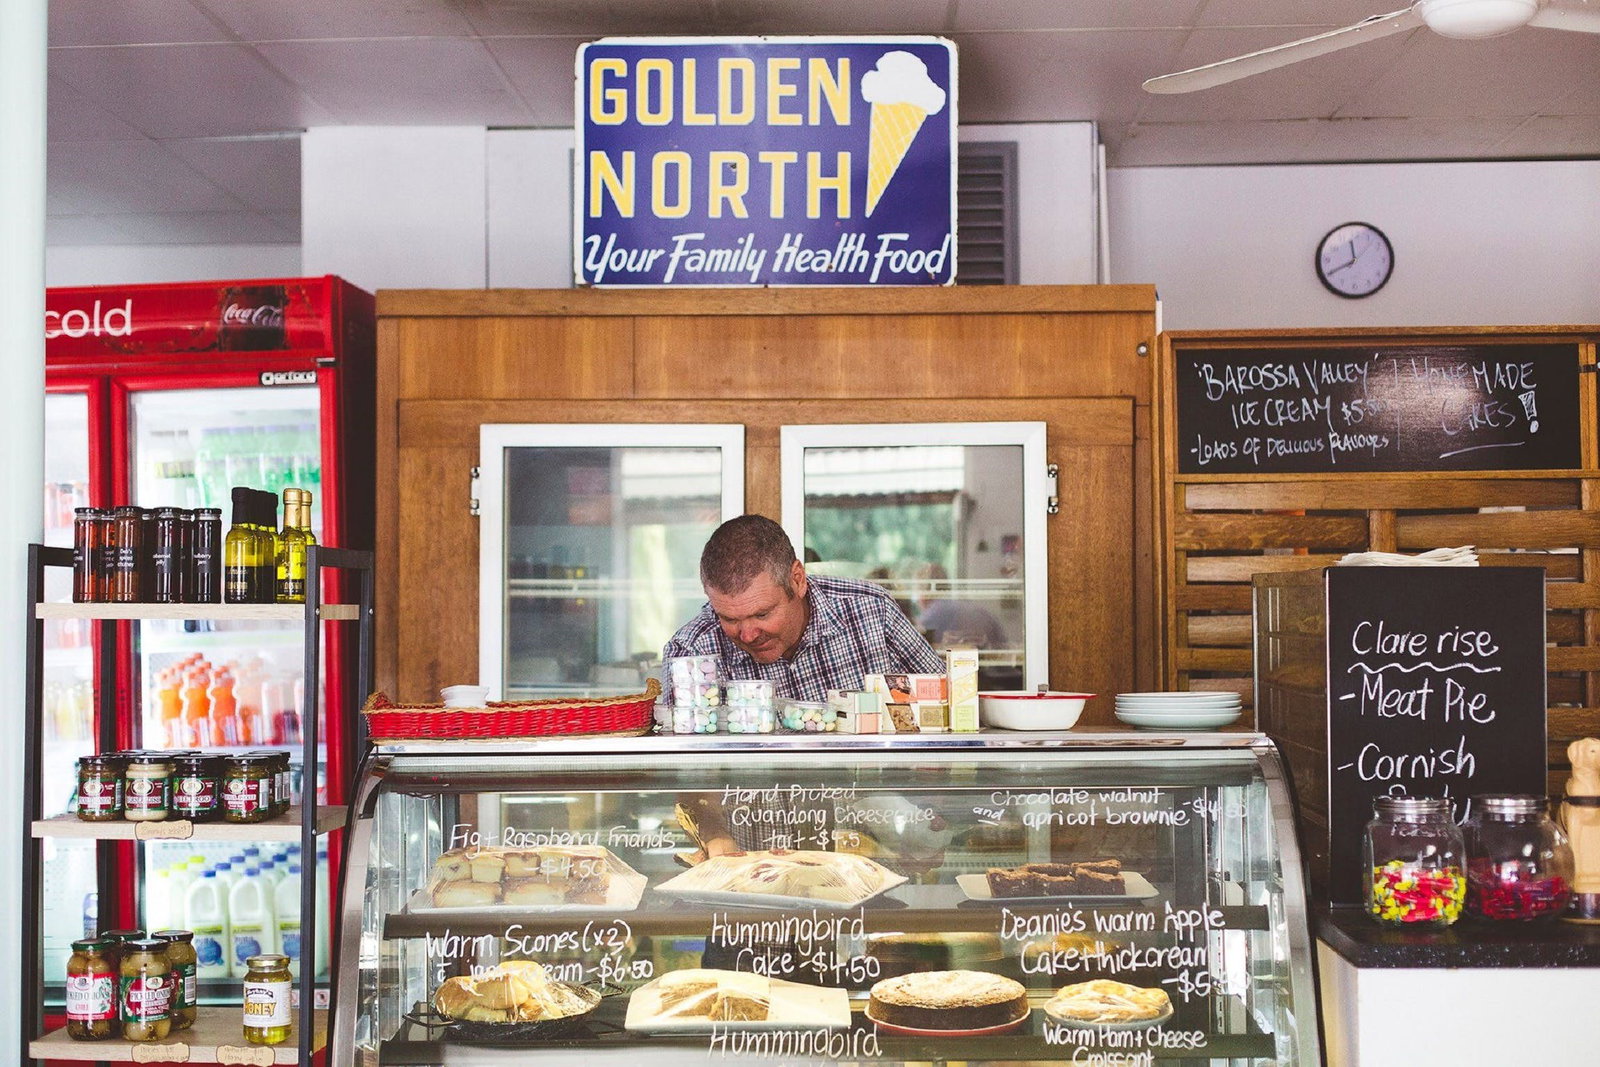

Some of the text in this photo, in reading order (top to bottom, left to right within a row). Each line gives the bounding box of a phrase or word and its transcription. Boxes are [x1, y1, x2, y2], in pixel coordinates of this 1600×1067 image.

[589, 57, 851, 126] GOLDEN
[589, 150, 852, 219] NORTH
[584, 232, 952, 284] Your Family Health Food
[1231, 401, 1261, 429] ICE
[1264, 394, 1335, 433] CREAM
[1242, 437, 1261, 465] OF
[1351, 620, 1500, 657] Clare rise
[1445, 677, 1496, 724] Pie
[721, 781, 857, 806] Hand Picked
[1099, 787, 1165, 805] walnut
[731, 805, 826, 831] Quandong
[972, 805, 1005, 825] and
[1022, 806, 1100, 832] apricot
[1105, 806, 1191, 827] brownie
[503, 826, 599, 850] Raspberry
[762, 829, 806, 850] tart
[711, 906, 869, 956] Hummingbird
[1000, 901, 1087, 941] Deanie's
[1163, 900, 1226, 943] Apple
[736, 947, 795, 978] Cake
[708, 1022, 883, 1062] Hummingbird
[1146, 1024, 1209, 1050] Cheese
